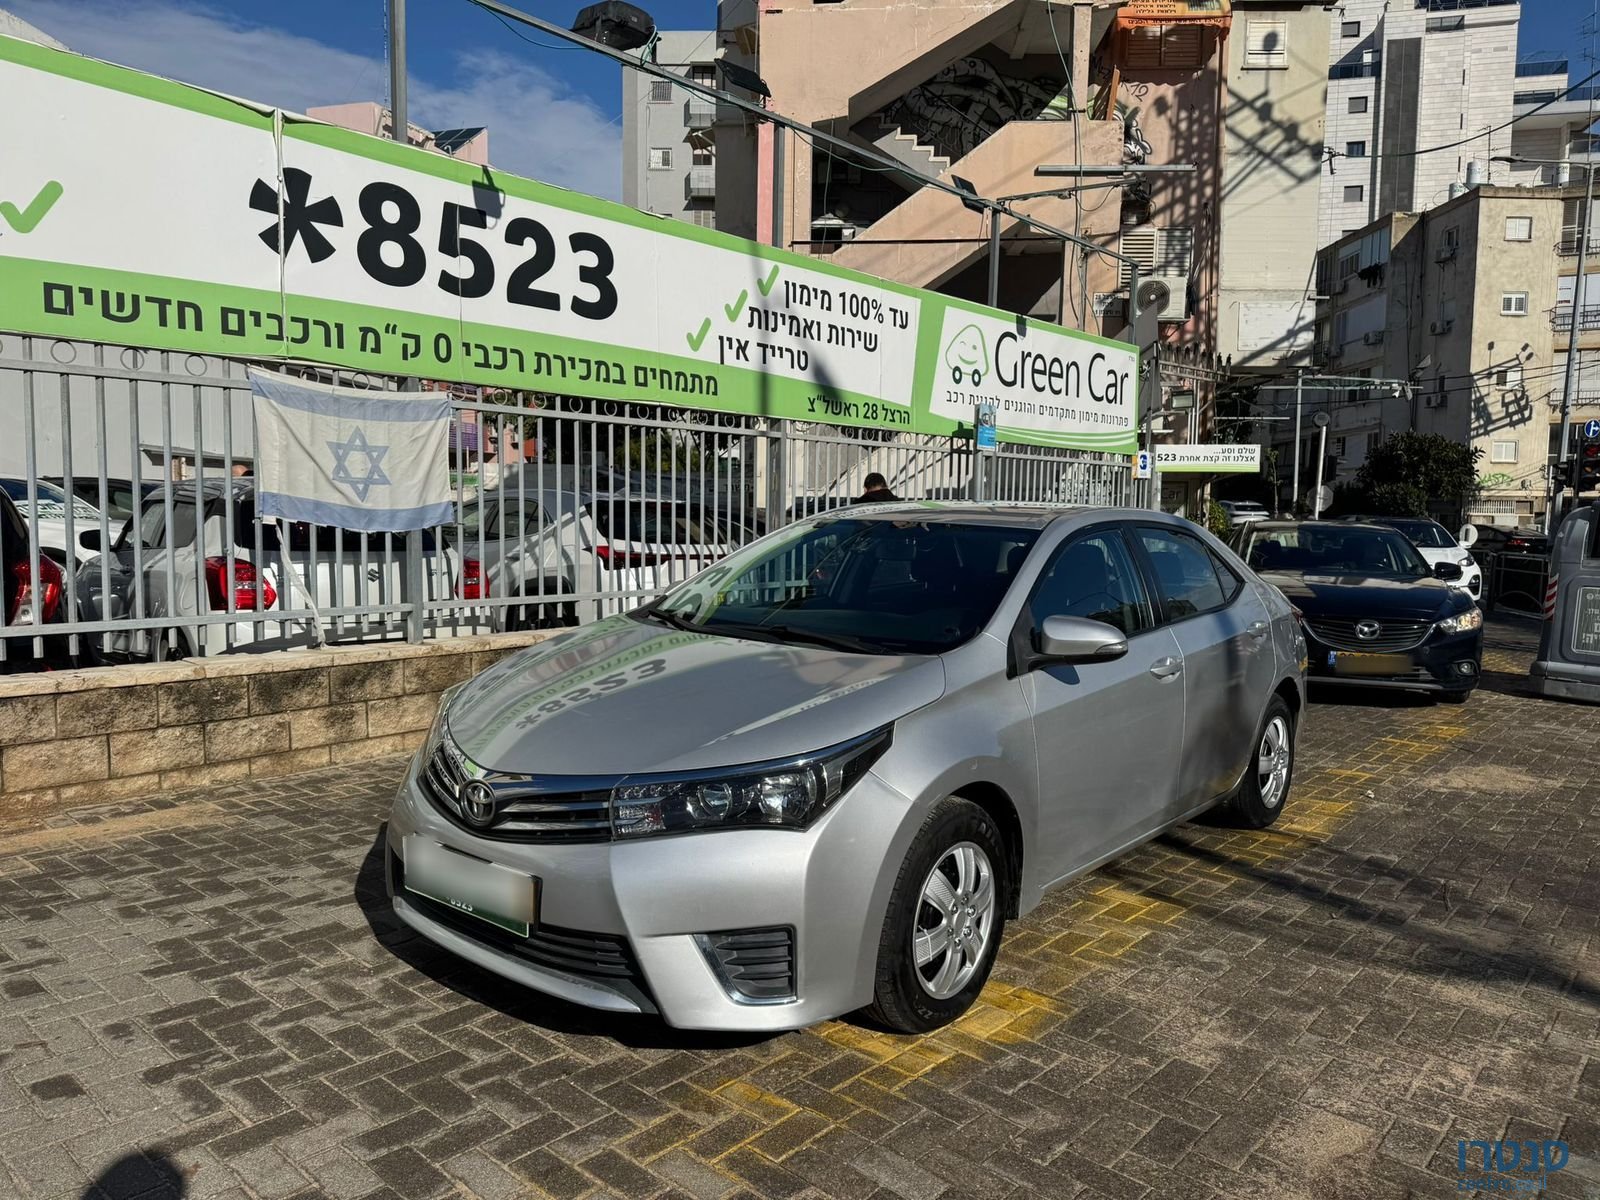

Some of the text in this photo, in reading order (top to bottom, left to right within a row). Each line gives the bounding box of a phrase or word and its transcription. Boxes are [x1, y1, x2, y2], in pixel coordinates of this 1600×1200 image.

[43, 282, 203, 332] חדשים
[784, 280, 908, 329] עד 100% מימון
[220, 306, 345, 350] ורכבים
[747, 306, 878, 352] שירות ואמינות
[433, 333, 452, 363] 0
[462, 342, 525, 373] רכבי
[718, 335, 809, 371] טרייד אין
[533, 351, 626, 385] במכירת
[634, 365, 718, 396] מתמחים
[994, 331, 1129, 406] Green Car
[863, 403, 879, 420] 28
[946, 390, 965, 404] רכב
[1004, 400, 1035, 415] והוגנים
[881, 404, 910, 425] הרצל
[1039, 406, 1076, 421] מתקדמים
[1079, 410, 1098, 424] מימון
[1100, 413, 1129, 427] פתרונות
[1203, 455, 1220, 464] קצת
[1237, 446, 1256, 454] שלם
